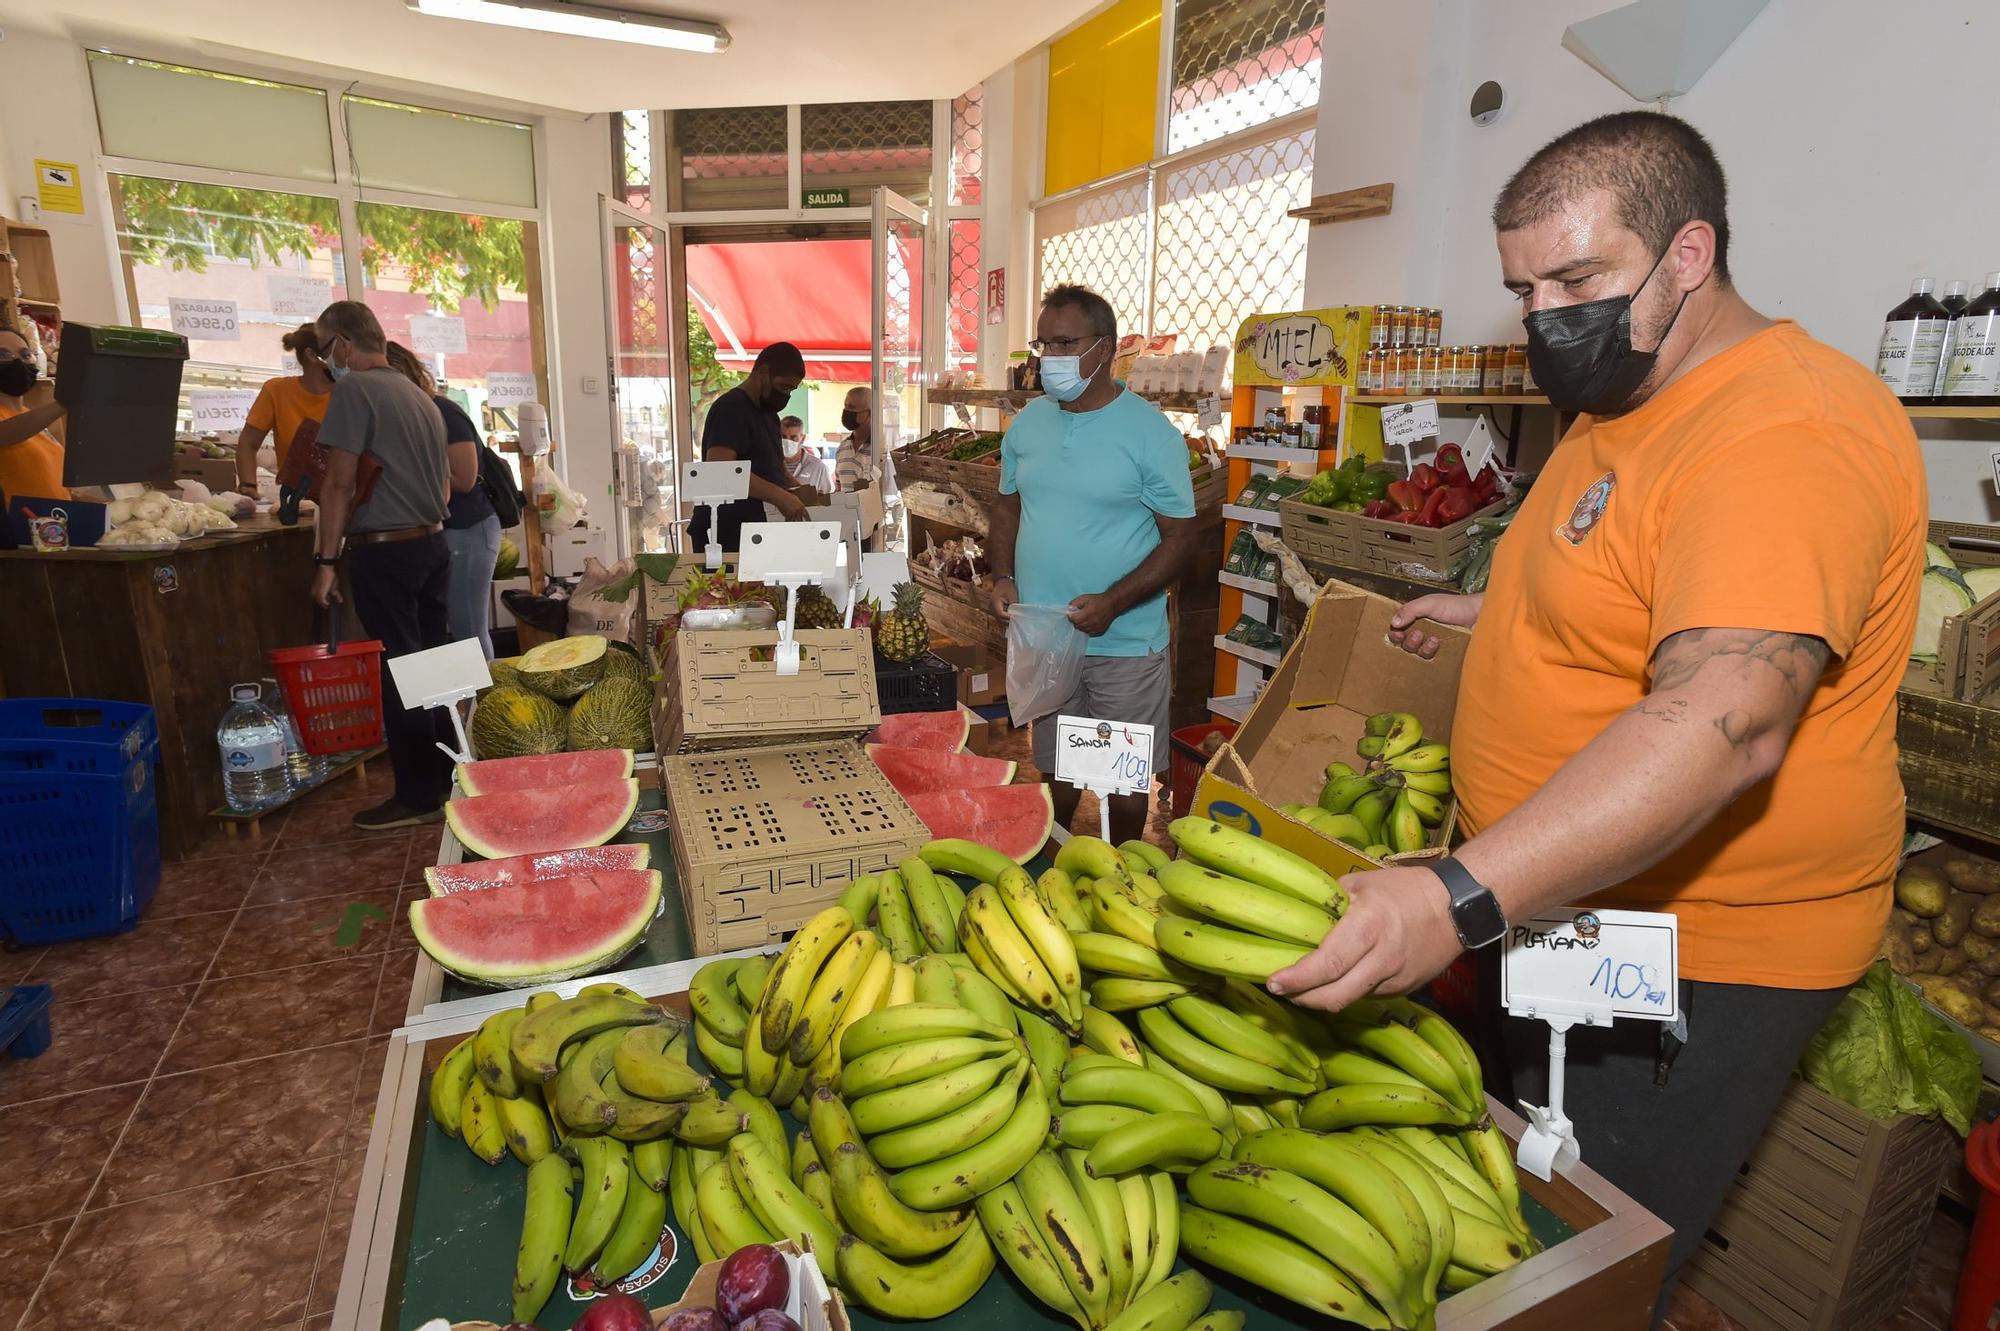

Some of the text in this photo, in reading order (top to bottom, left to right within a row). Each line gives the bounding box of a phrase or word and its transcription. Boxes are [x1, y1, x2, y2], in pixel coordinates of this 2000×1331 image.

[808, 193, 844, 205] SALIDA
[1976, 346, 1996, 355] ALOE
[596, 620, 614, 631] DE
[1068, 733, 1111, 749] SANDIA
[616, 1256, 668, 1292] SU CASA
